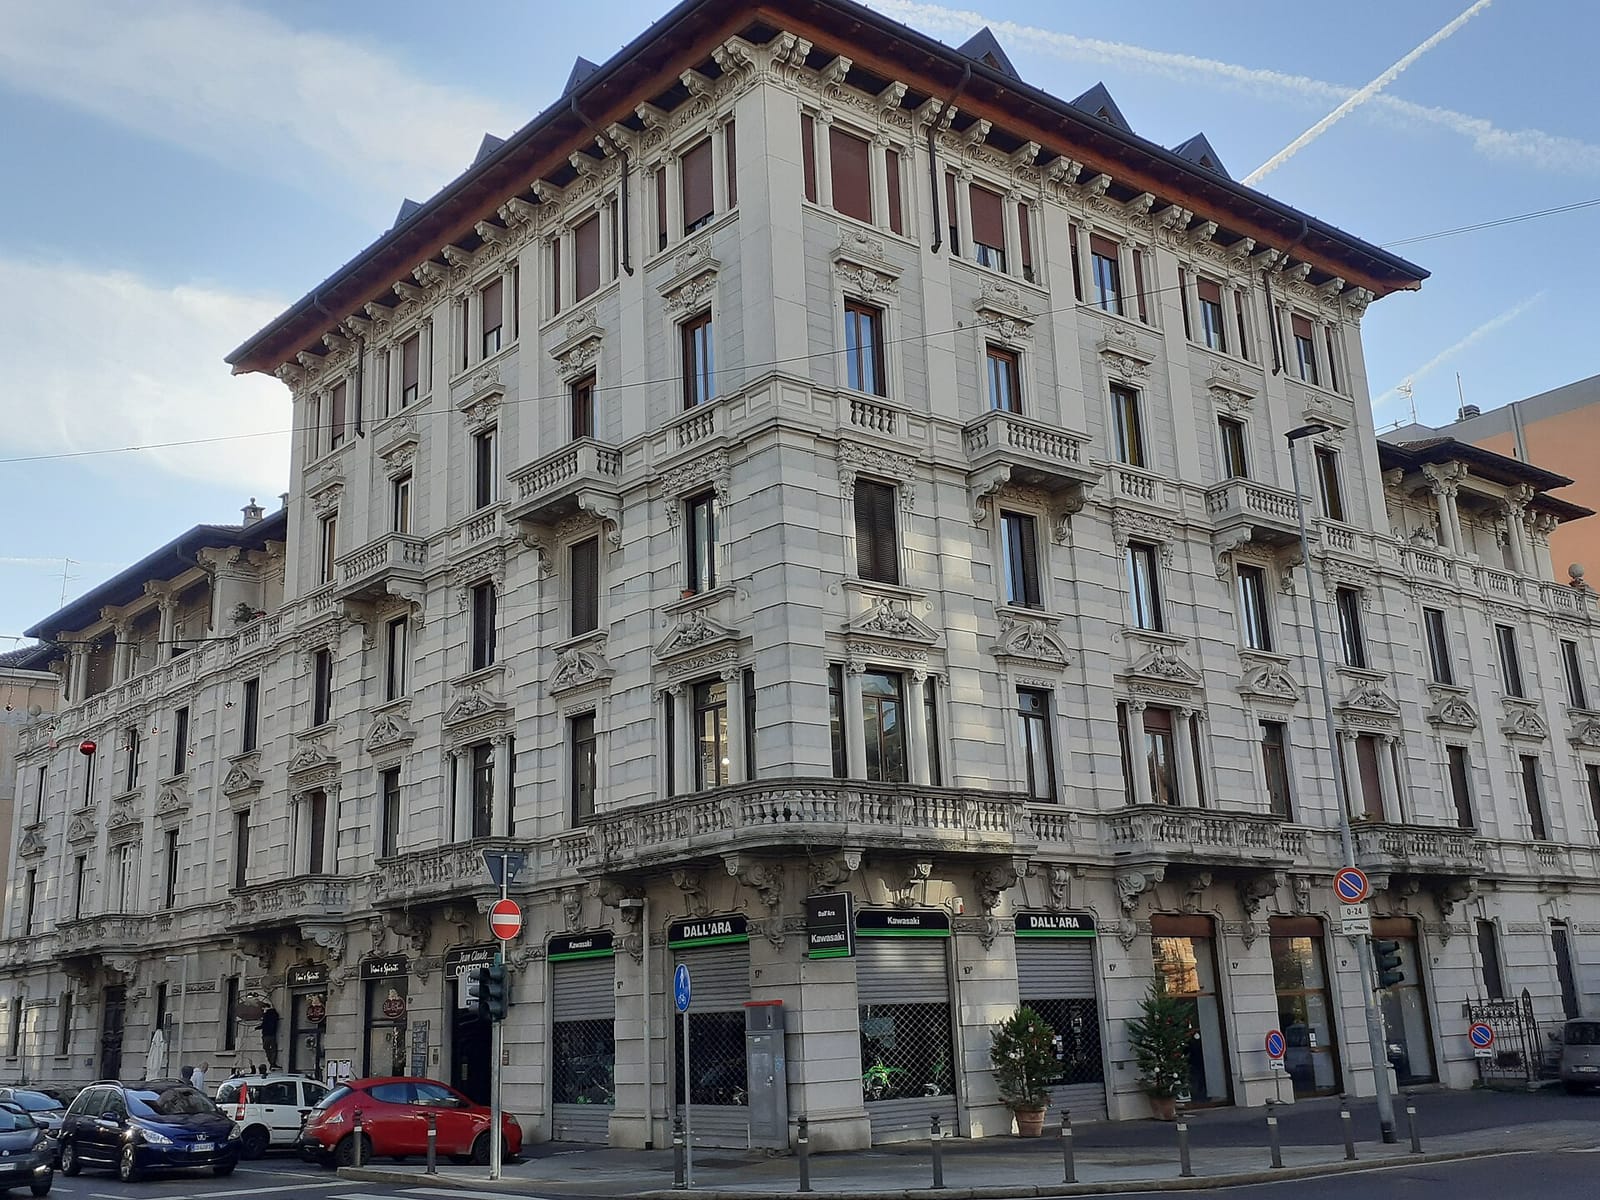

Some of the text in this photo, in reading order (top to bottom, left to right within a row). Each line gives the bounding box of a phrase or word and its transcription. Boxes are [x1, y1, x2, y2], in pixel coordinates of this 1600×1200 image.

[1346, 907, 1363, 915] 0-24
[887, 916, 920, 925] Kawasaki
[1029, 916, 1080, 929] DALL'ARA
[683, 921, 732, 938] DALL'ARA
[811, 931, 845, 943] Kawasaki
[568, 938, 593, 949] Kawasaki
